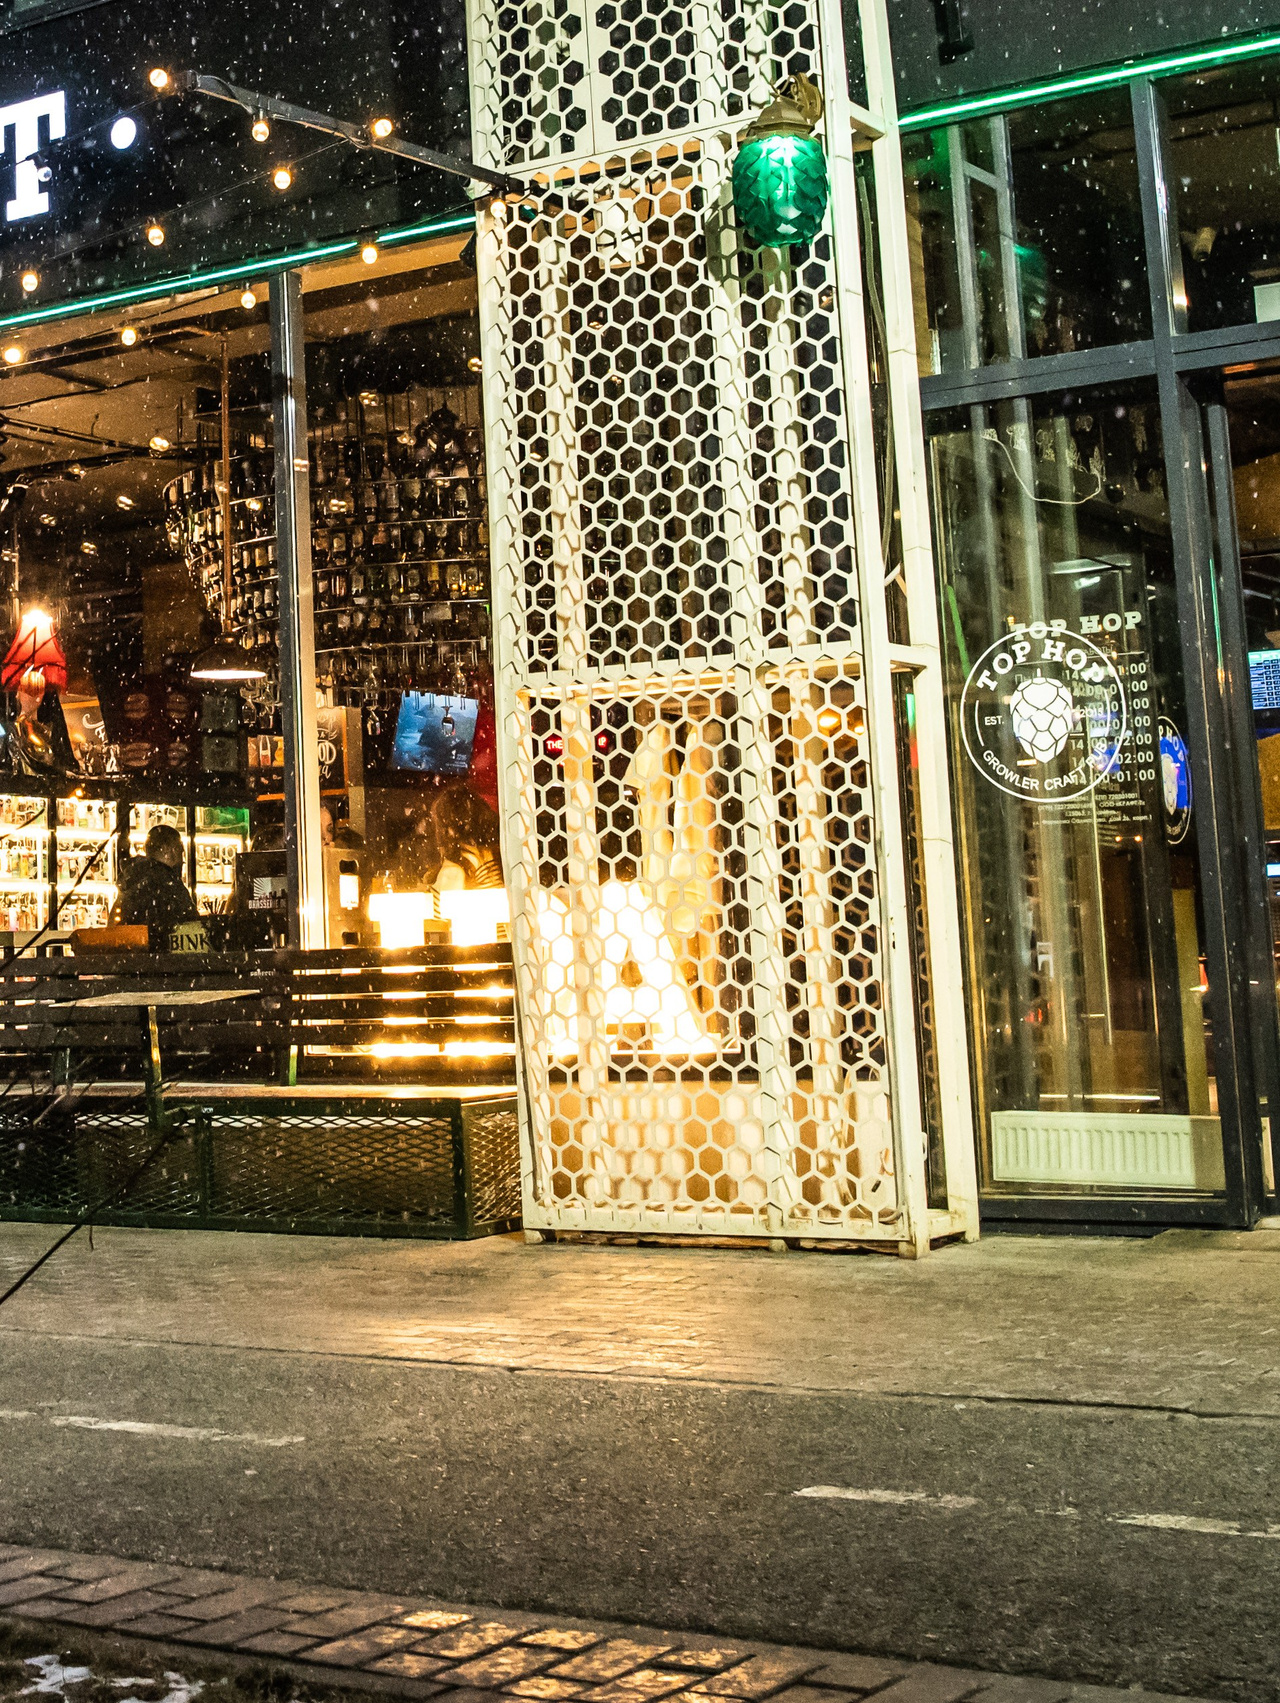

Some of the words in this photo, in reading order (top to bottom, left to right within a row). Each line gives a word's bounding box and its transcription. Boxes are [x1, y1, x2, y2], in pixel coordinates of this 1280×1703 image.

[1010, 618, 1067, 641] TOP
[1079, 611, 1142, 634] HOP
[976, 641, 1031, 691] TOP
[1041, 638, 1104, 683] HOP
[984, 715, 1004, 726] EST.
[982, 749, 1040, 791] GROWLER
[1043, 766, 1086, 791] CRAFT
[1084, 741, 1108, 769] PUB
